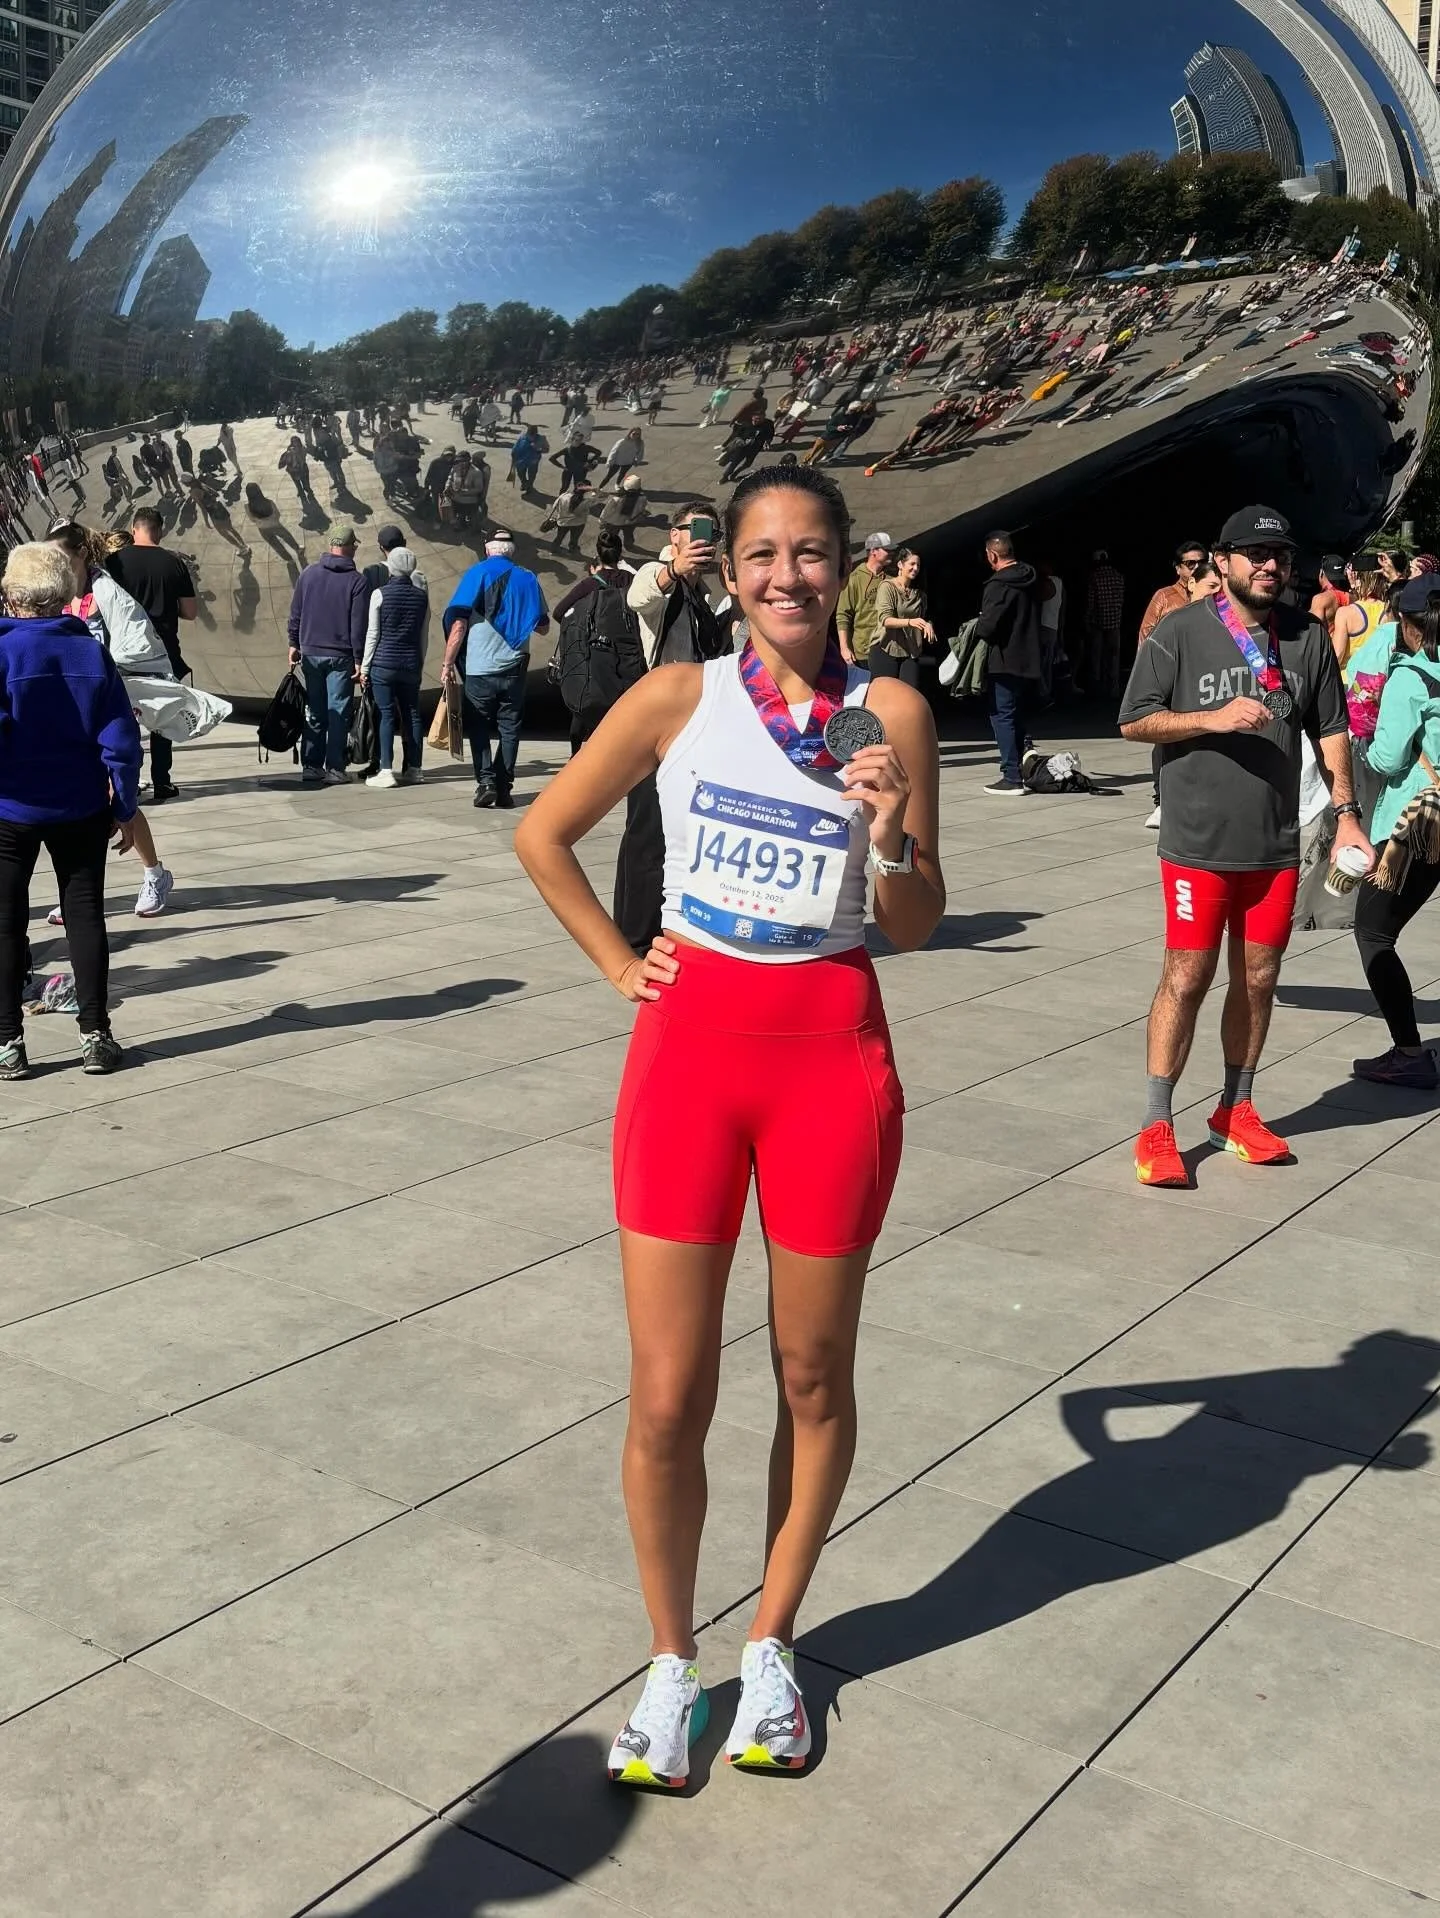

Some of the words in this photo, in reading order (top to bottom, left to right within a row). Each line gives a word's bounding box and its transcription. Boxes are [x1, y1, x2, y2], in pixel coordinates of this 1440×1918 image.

[1199, 666, 1304, 706] SATIY
[716, 804, 751, 819] CHICAGO
[751, 812, 798, 830] MARATHON
[719, 796, 737, 806] BANK
[738, 800, 747, 808] OF
[747, 802, 778, 815] AMERICA
[816, 818, 840, 833] RUN
[689, 825, 827, 896] J44931
[719, 882, 750, 896] October
[751, 890, 763, 900] 12,
[765, 893, 785, 904] 2025
